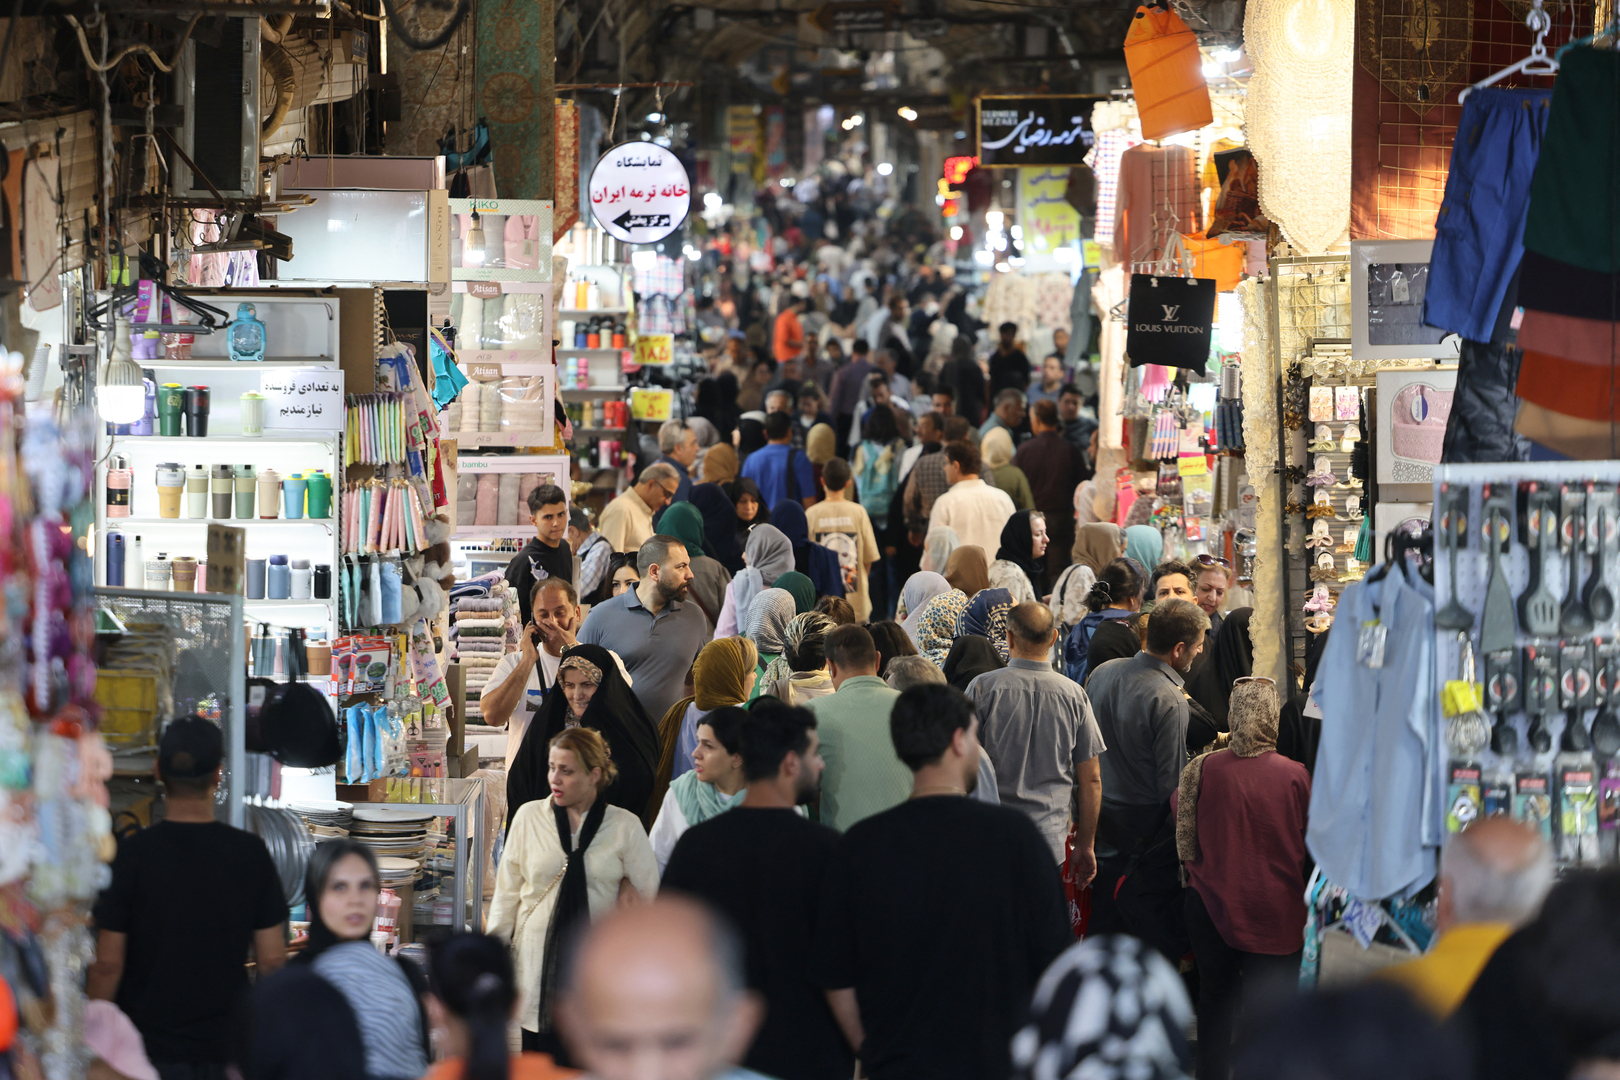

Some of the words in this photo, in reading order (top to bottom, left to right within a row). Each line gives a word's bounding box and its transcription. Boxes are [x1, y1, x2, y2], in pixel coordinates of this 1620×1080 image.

[1050, 116, 1084, 145] ترمه
[616, 155, 663, 170] نمایشگاه
[592, 184, 626, 204] ایران
[630, 184, 656, 203] ترمه
[661, 183, 688, 198] خانه
[469, 200, 499, 210] KIKO
[624, 215, 649, 228] پخش
[649, 215, 671, 227] مرکز
[472, 283, 498, 294] Atisan
[1135, 323, 1162, 332] LOUIS
[1163, 325, 1203, 334] VUITTON
[472, 366, 499, 376] Atisan
[265, 380, 296, 395] فروشنده
[298, 381, 329, 395] تعدادی
[331, 384, 340, 395] به
[280, 403, 322, 418] نیازمندیم
